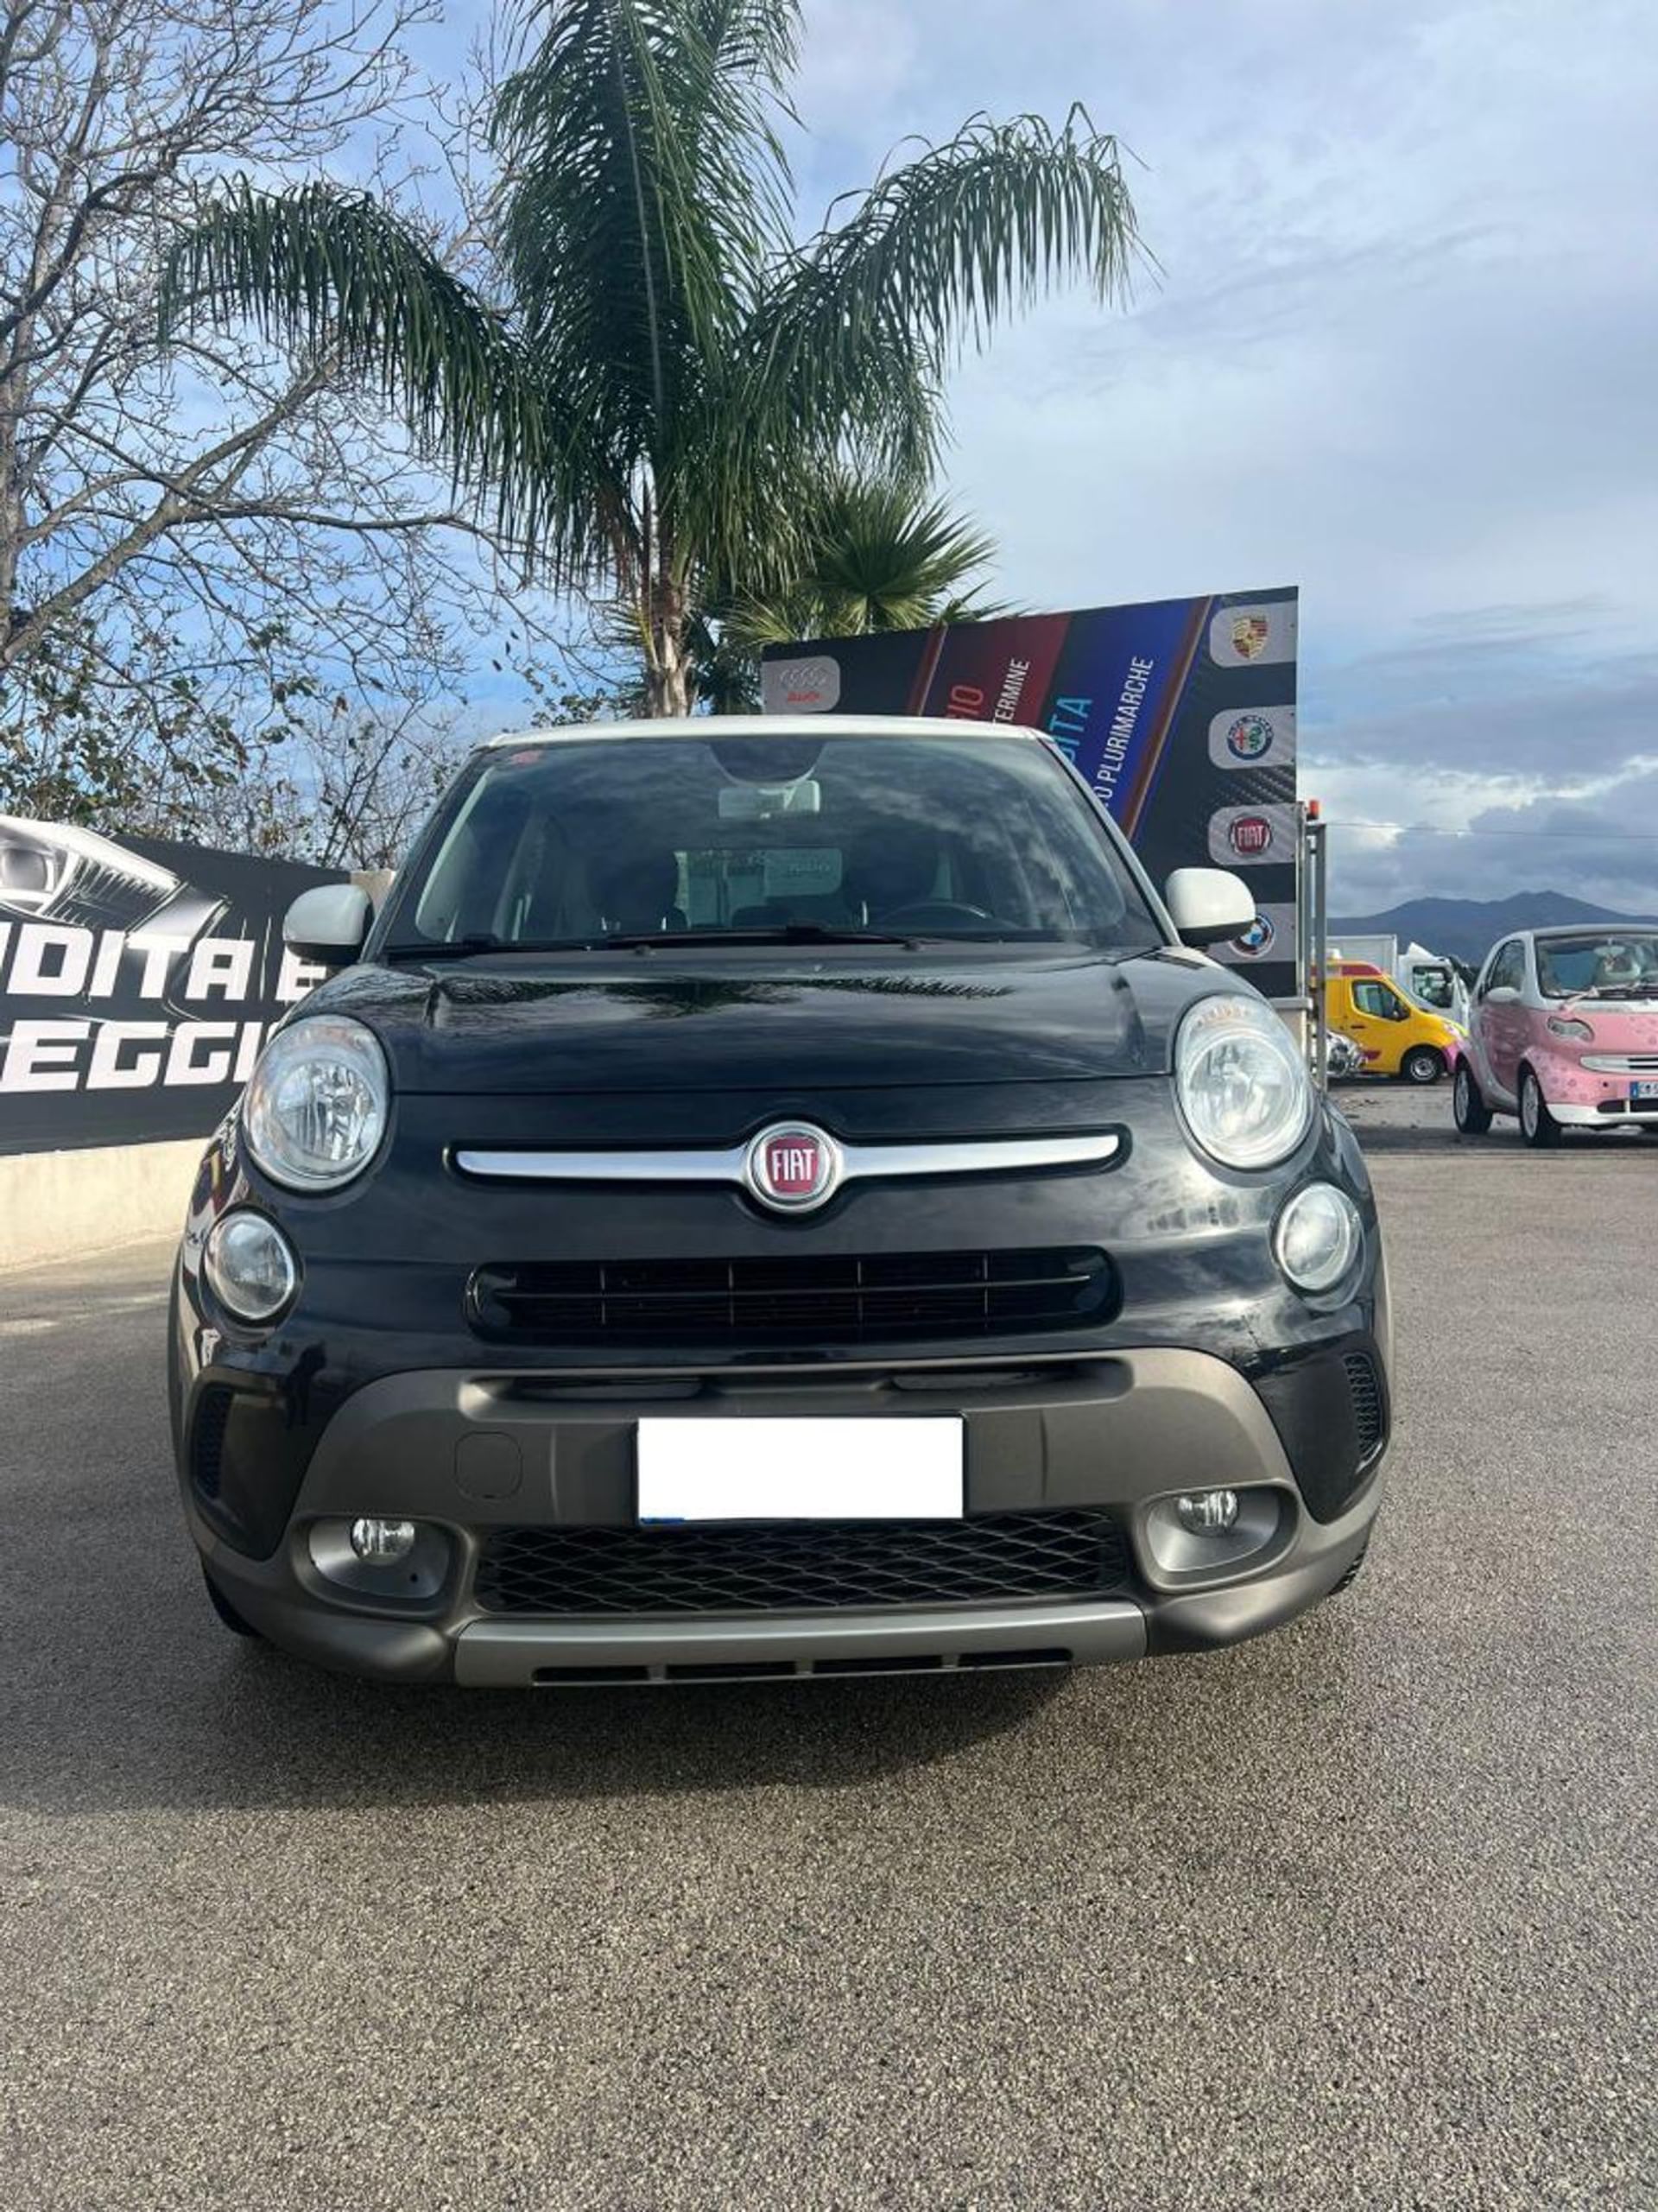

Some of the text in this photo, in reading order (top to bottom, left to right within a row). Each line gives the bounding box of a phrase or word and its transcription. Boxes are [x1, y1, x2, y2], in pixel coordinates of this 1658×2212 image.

[947, 685, 984, 719] IO
[1097, 656, 1155, 783] PLURIMARCHE
[0, 921, 256, 1001] DITA
[0, 1020, 280, 1093] EGGI
[771, 1148, 816, 1182] FIAT
